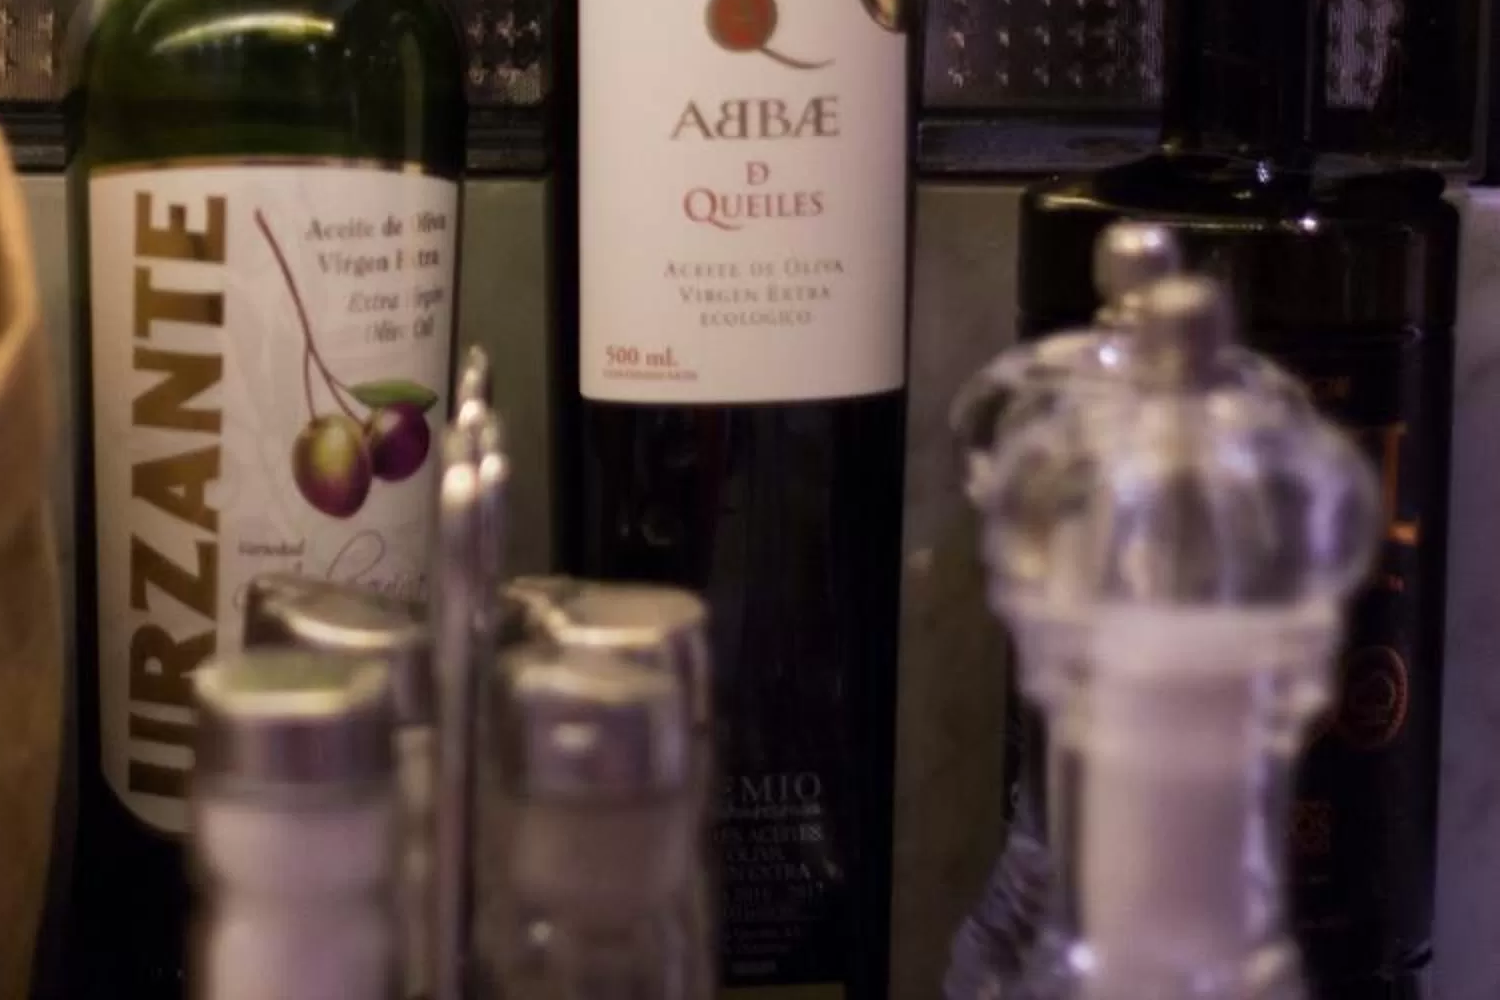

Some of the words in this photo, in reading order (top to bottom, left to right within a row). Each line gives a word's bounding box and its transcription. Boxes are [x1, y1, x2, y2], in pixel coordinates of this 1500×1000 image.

[683, 187, 825, 231] QUEILES
[382, 212, 404, 237] de
[605, 344, 639, 365] 500
